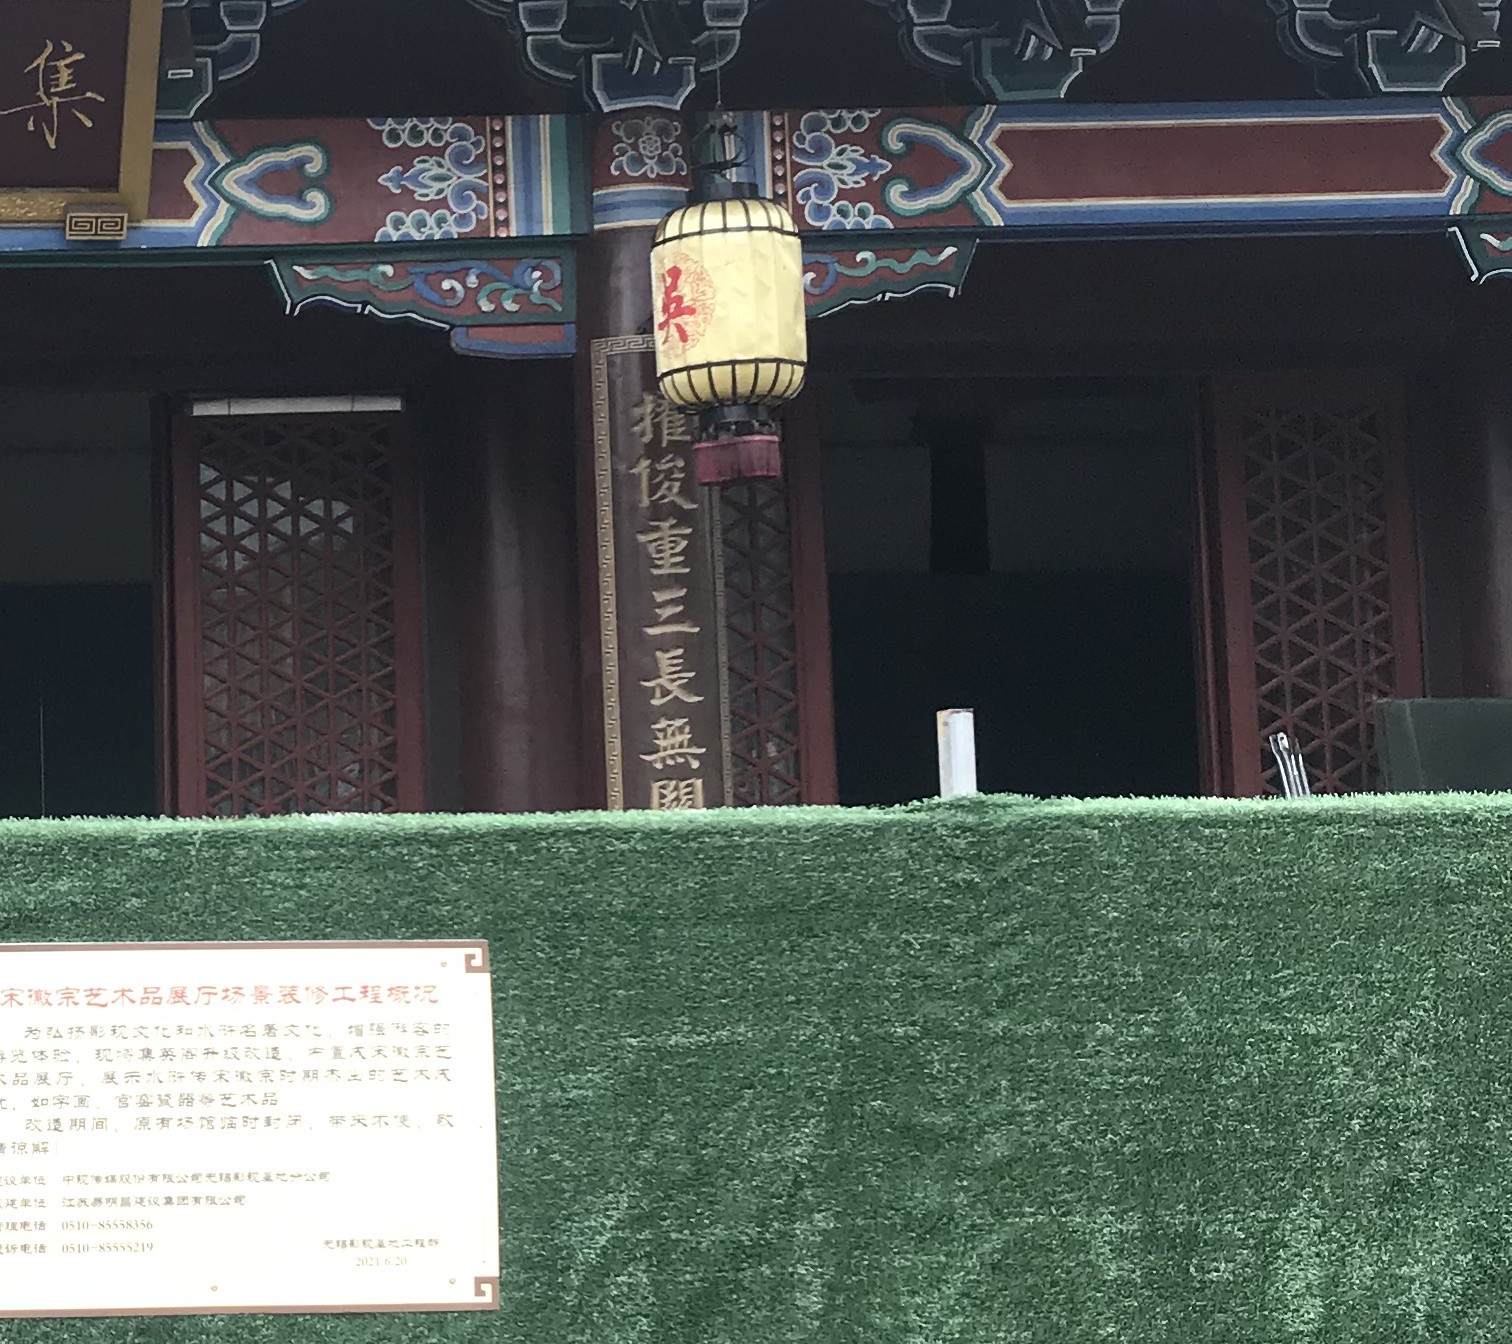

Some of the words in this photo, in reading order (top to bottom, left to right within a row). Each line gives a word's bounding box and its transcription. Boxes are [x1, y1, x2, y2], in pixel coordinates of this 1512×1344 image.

[0, 984, 440, 1008] 宋徽宗艺术品展厅场景装修工程概况
